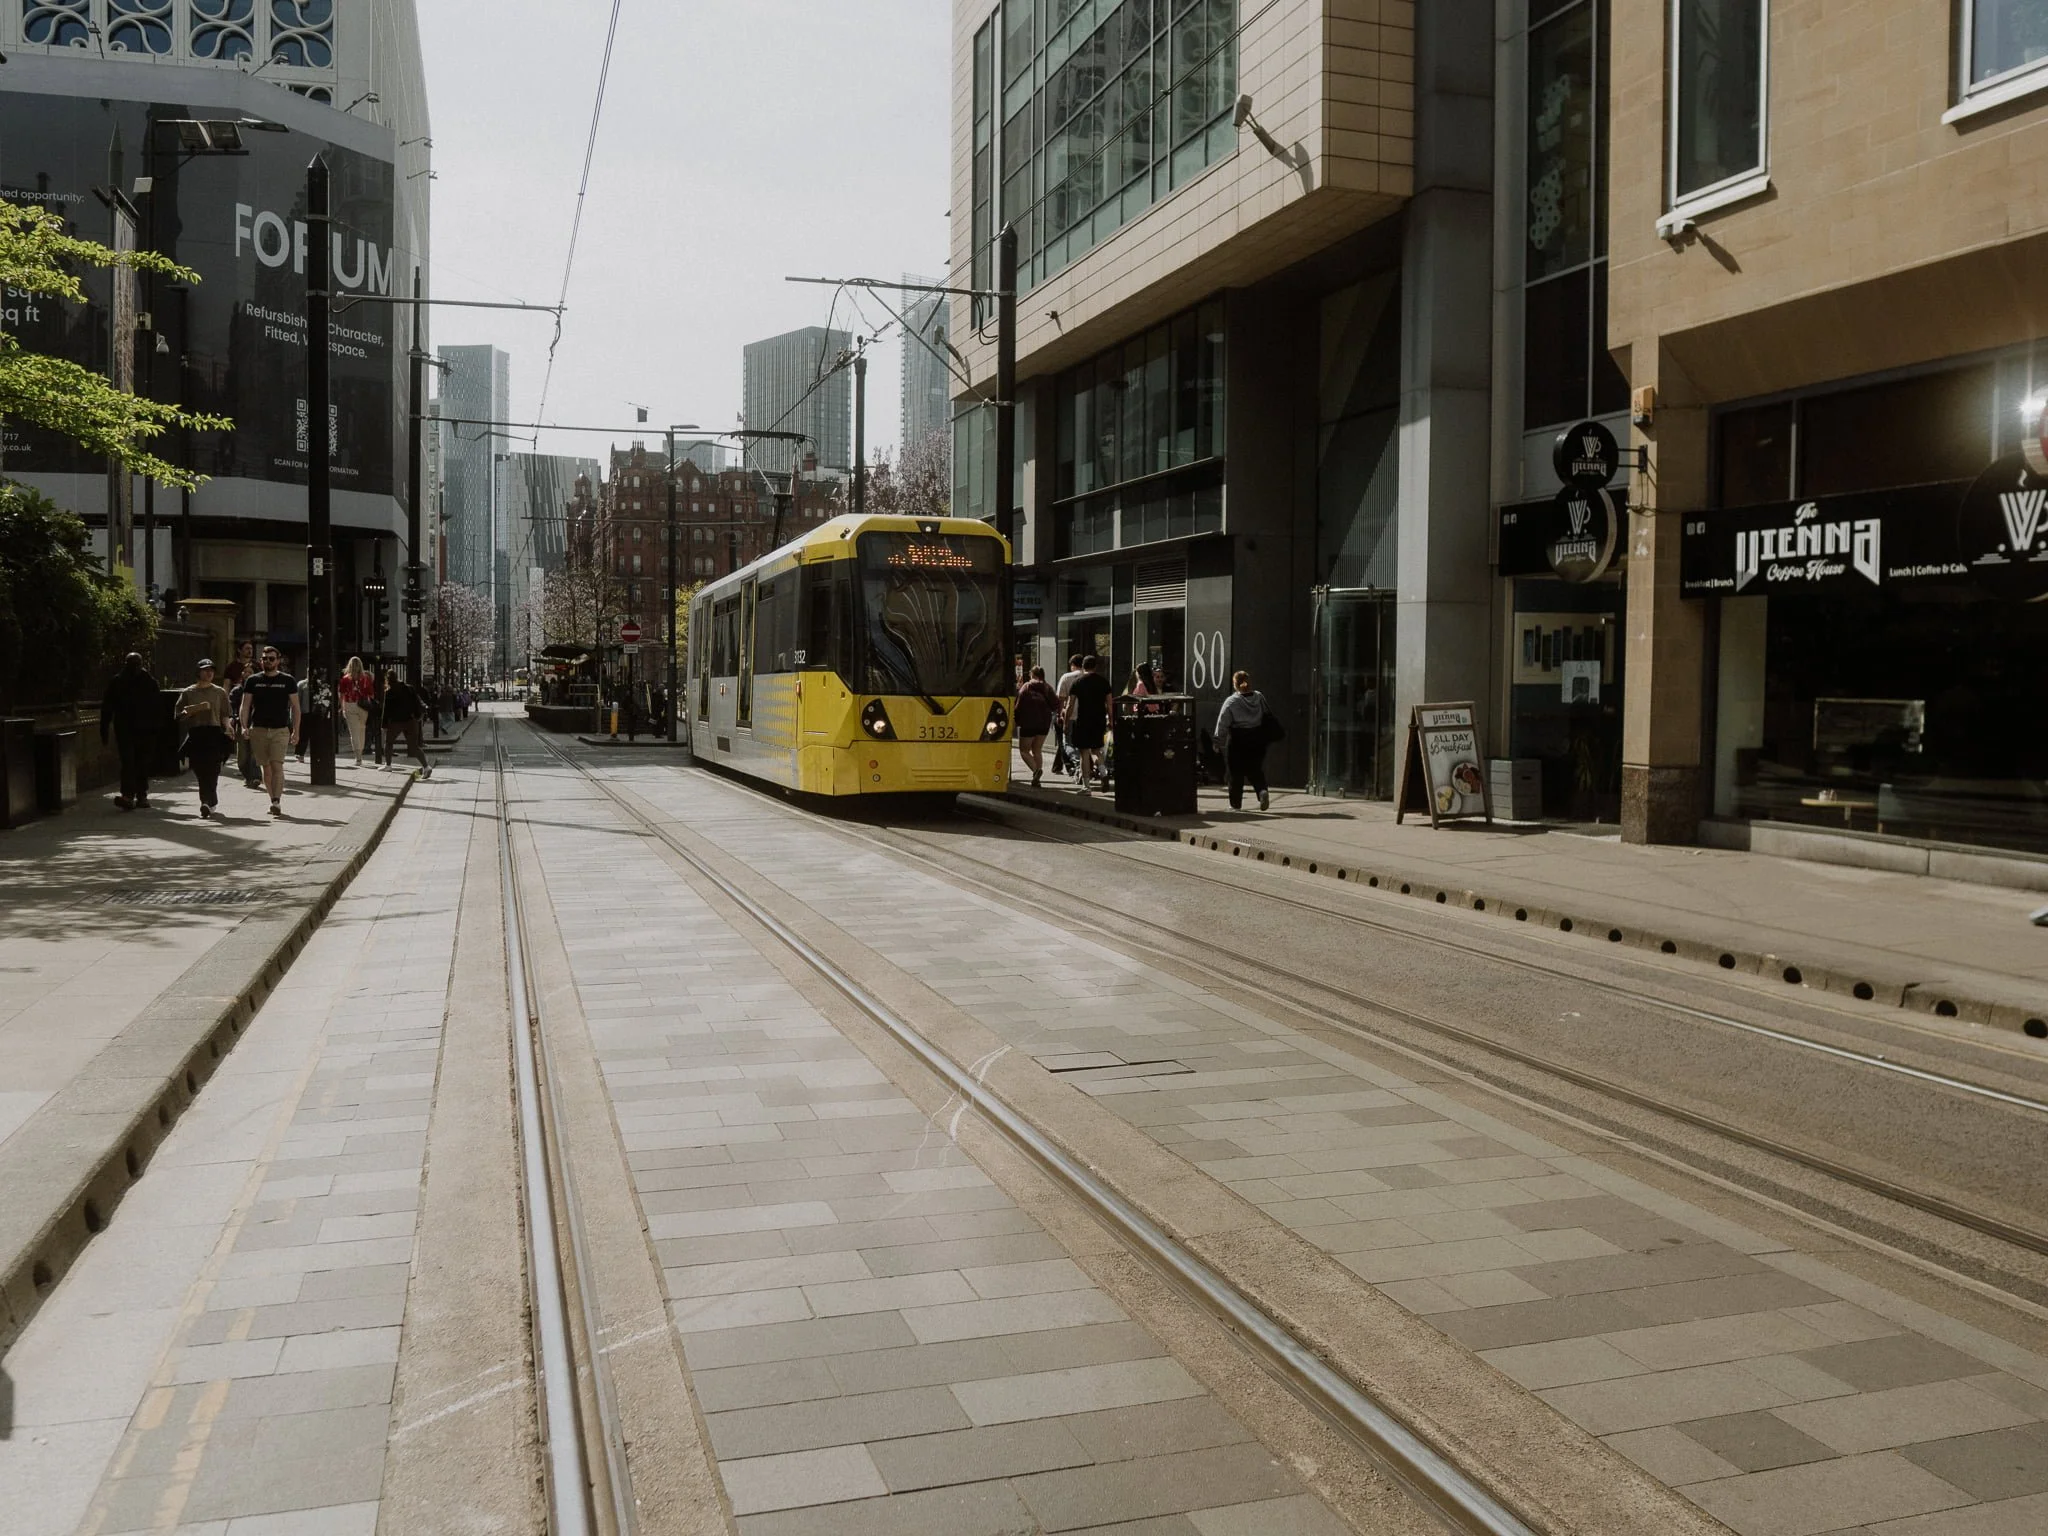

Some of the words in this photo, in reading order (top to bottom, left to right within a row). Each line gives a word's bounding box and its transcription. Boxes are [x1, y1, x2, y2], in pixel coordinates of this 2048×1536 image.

[20, 190, 85, 203] opportunity:
[25, 306, 40, 322] ft
[246, 303, 308, 328] Refursbish
[328, 322, 384, 347] Character,
[264, 325, 300, 346] Fitted,
[1794, 502, 1819, 525] The
[1736, 518, 1881, 593] VIENNA
[1766, 562, 1805, 582] Coffee
[1806, 558, 1846, 582] House
[1889, 567, 1911, 577] Lunch
[1916, 564, 1942, 575] Coffee
[1192, 630, 1225, 690] 80
[1434, 735, 1451, 743] ALL
[1453, 733, 1469, 742] DAY
